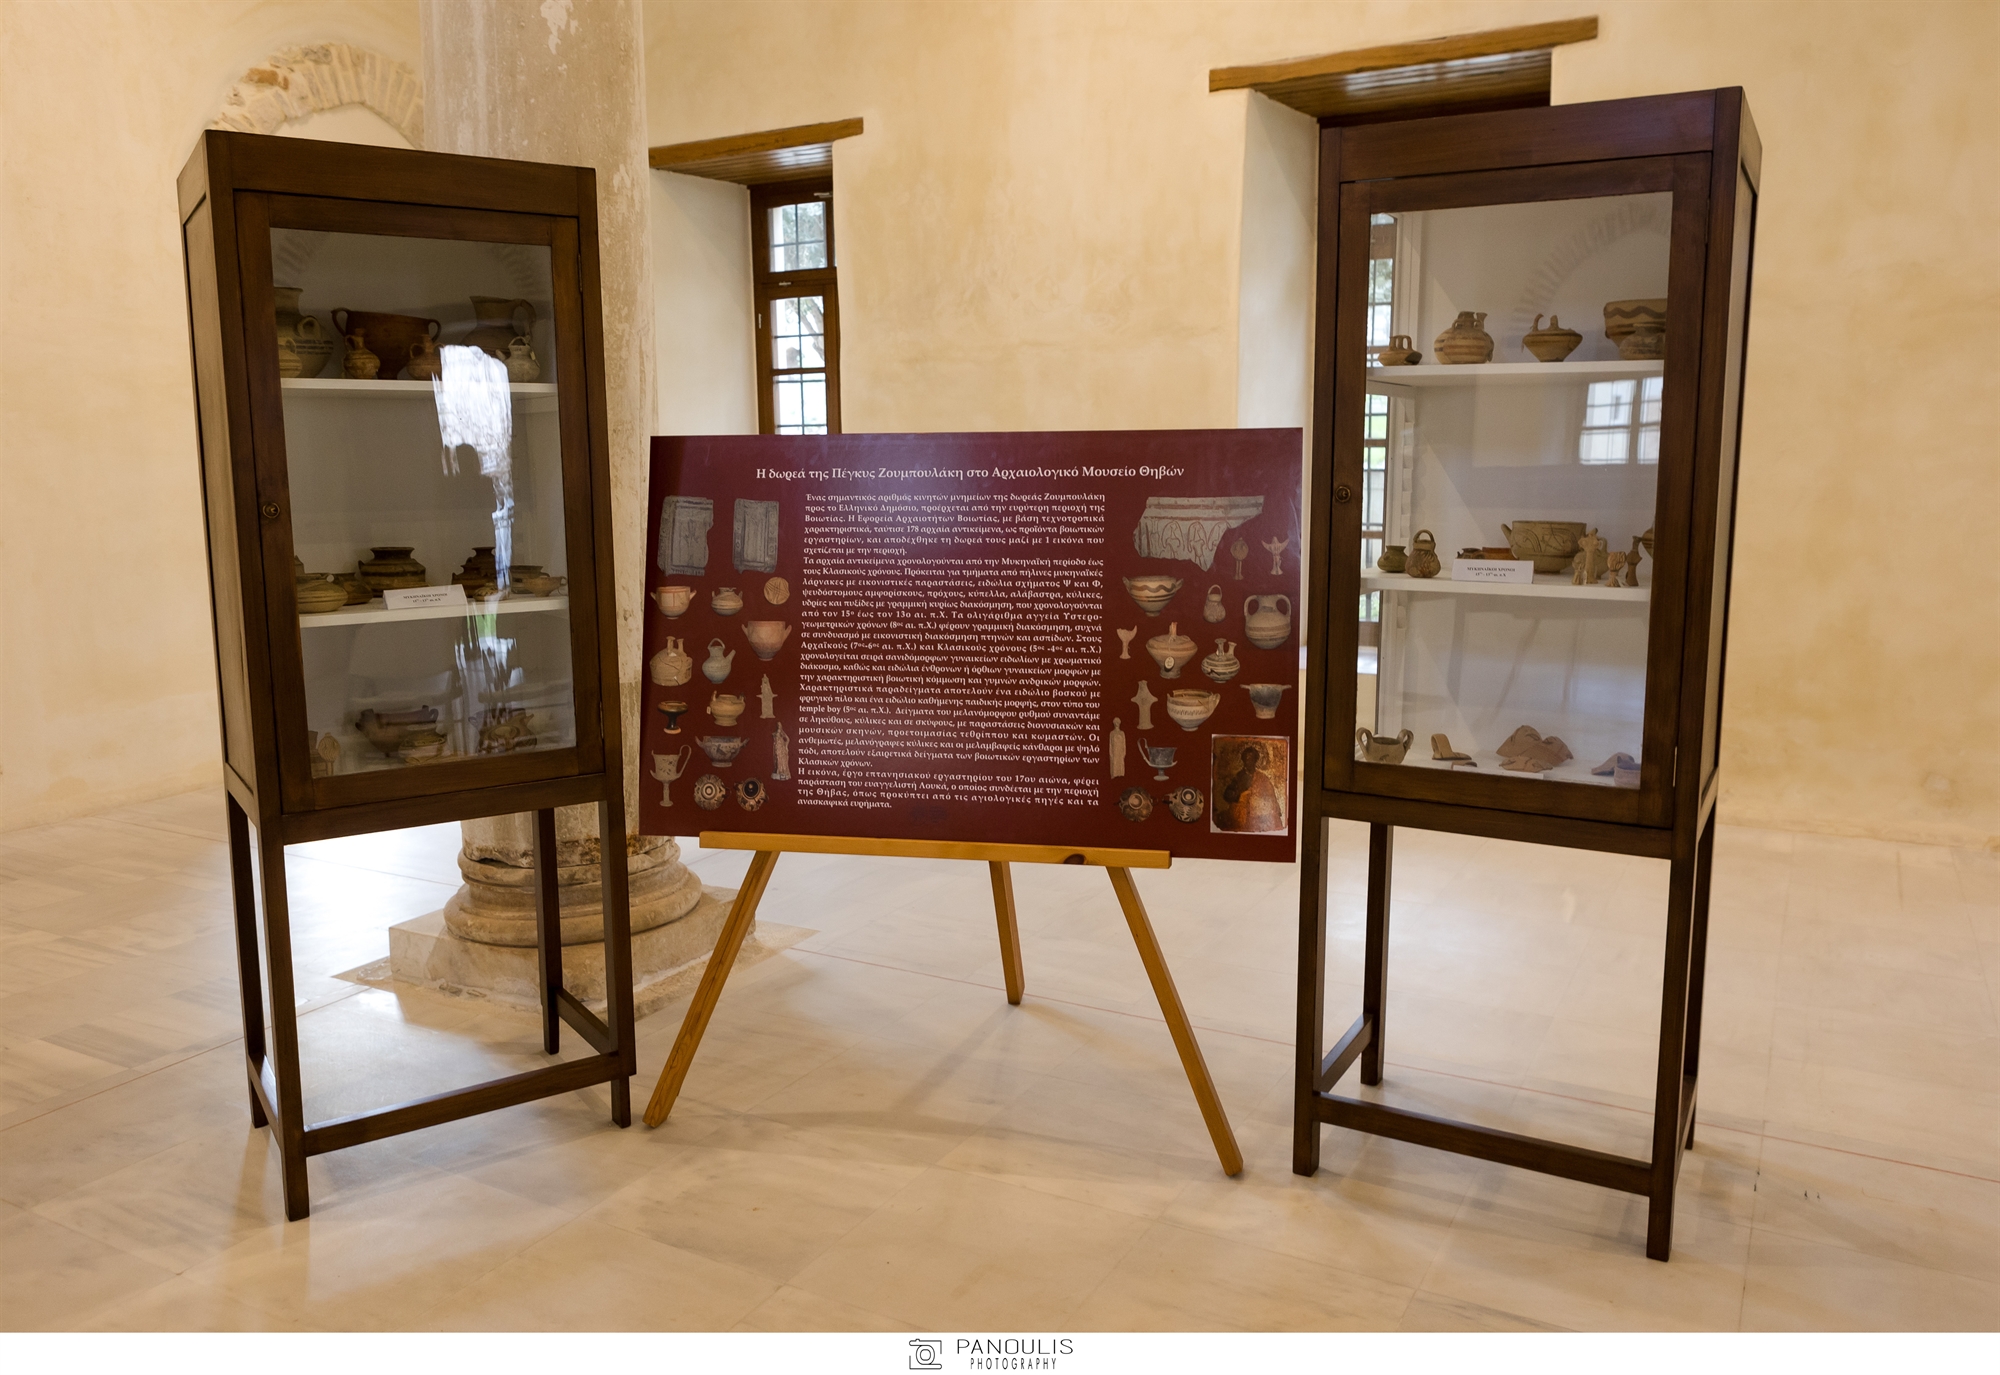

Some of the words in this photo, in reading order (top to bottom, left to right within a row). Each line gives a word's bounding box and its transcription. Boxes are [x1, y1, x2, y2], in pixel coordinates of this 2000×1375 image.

[756, 468, 766, 479] Η
[768, 468, 806, 481] δωρεά
[808, 470, 829, 482] της
[832, 467, 876, 481] Πέγκυς
[878, 467, 963, 481] Ζουμπουλάκη
[966, 469, 989, 478] στο
[991, 466, 1079, 480] Αρχαιολογικό
[1082, 465, 1137, 477] Μουσείο
[1139, 465, 1185, 480] Θηβών
[828, 494, 876, 503] σημαντικός
[878, 494, 911, 502] αριθμός
[914, 493, 948, 502] κινητών
[950, 493, 991, 503] μνημείων
[1010, 493, 1042, 502] δωρεάς
[1044, 493, 1105, 502] Ζουμπουλάκη
[839, 504, 878, 513] Ελληνικό
[921, 504, 969, 513] προέρχεται
[991, 505, 1007, 513] την
[1009, 504, 1049, 513] ευρύτερη
[1051, 503, 1087, 513] περιοχή
[1089, 505, 1105, 513] της
[858, 515, 893, 524] Εφορεία
[896, 515, 955, 524] Αρχαιοτήτων
[1002, 516, 1012, 524] με
[1015, 514, 1039, 524] βάση
[1041, 514, 1105, 524] τεχνοτροπικά
[920, 525, 950, 534] αρχαία
[1019, 525, 1058, 535] προϊόντα
[1059, 525, 1104, 535] βοιωτικών
[803, 546, 844, 555] σχετίζεται
[846, 548, 855, 556] με
[857, 548, 872, 556] την
[823, 567, 866, 575] Κλασικούς
[904, 568, 945, 577] Πρόκειται
[962, 568, 999, 578] τμήματα
[1000, 568, 1018, 576] από
[1019, 568, 1052, 578] πήλινες
[1053, 569, 1103, 578] μυκηναϊκές
[802, 578, 844, 587] λάρνακες
[858, 578, 913, 587] εικονιστικές
[978, 579, 1013, 587] ειδώλια
[1015, 579, 1060, 589] σχήματος
[1063, 579, 1071, 587] Ψ
[802, 599, 827, 608] υδρίες
[844, 599, 874, 607] πυξίδες
[876, 601, 885, 609] με
[887, 600, 927, 610] γραμμική
[929, 600, 958, 610] κυρίως
[1033, 601, 1102, 611] χρονολογούνται
[812, 631, 860, 641] συνδυασμό
[861, 633, 871, 641] με
[873, 632, 923, 642] εικονιστική
[924, 632, 978, 643] διακόσμηση
[980, 633, 1014, 643] πτηνών
[1076, 634, 1102, 643] Στους
[800, 652, 859, 661] χρονολογείται
[860, 653, 884, 662] σειρά
[885, 653, 948, 663] σανιδόμορφων
[950, 655, 998, 664] γυναικείων
[1000, 655, 1039, 663] ειδωλίων
[1053, 657, 1102, 666] χρωματικό
[800, 674, 815, 682] την
[816, 674, 884, 684] χαρακτηριστική
[886, 674, 924, 685] βοιωτική
[926, 675, 966, 686] κόμμωση
[984, 677, 1017, 686] γυμνών
[1019, 677, 1061, 687] ανδρικών
[799, 695, 833, 703] φρυγικό
[869, 695, 884, 703] ένα
[885, 696, 916, 704] ειδώλιο
[918, 697, 963, 707] καθήμενης
[965, 698, 1002, 708] παιδικής
[1062, 700, 1083, 708] τύπο
[854, 717, 886, 725] κύλικες
[957, 721, 967, 729] με
[969, 720, 1025, 729] παραστάσεις
[1027, 721, 1084, 730] διονυσιακών
[845, 738, 904, 748] μελανόγραφες
[906, 740, 938, 748] κύλικες
[966, 741, 1021, 752] μελαμβαφείς
[1022, 743, 1063, 753] κάνθαροι
[1076, 744, 1100, 754] ψηλό
[798, 757, 839, 766] Κλασικών
[798, 778, 846, 788] παράσταση
[864, 781, 917, 791] ευαγγελιστή
[958, 784, 987, 792] οποίος
[989, 784, 1032, 793] συνδέεται
[1034, 787, 1044, 795] με
[1046, 788, 1062, 796] την
[1064, 788, 1099, 798] περιοχή
[797, 799, 849, 808] ανασκαφικά
